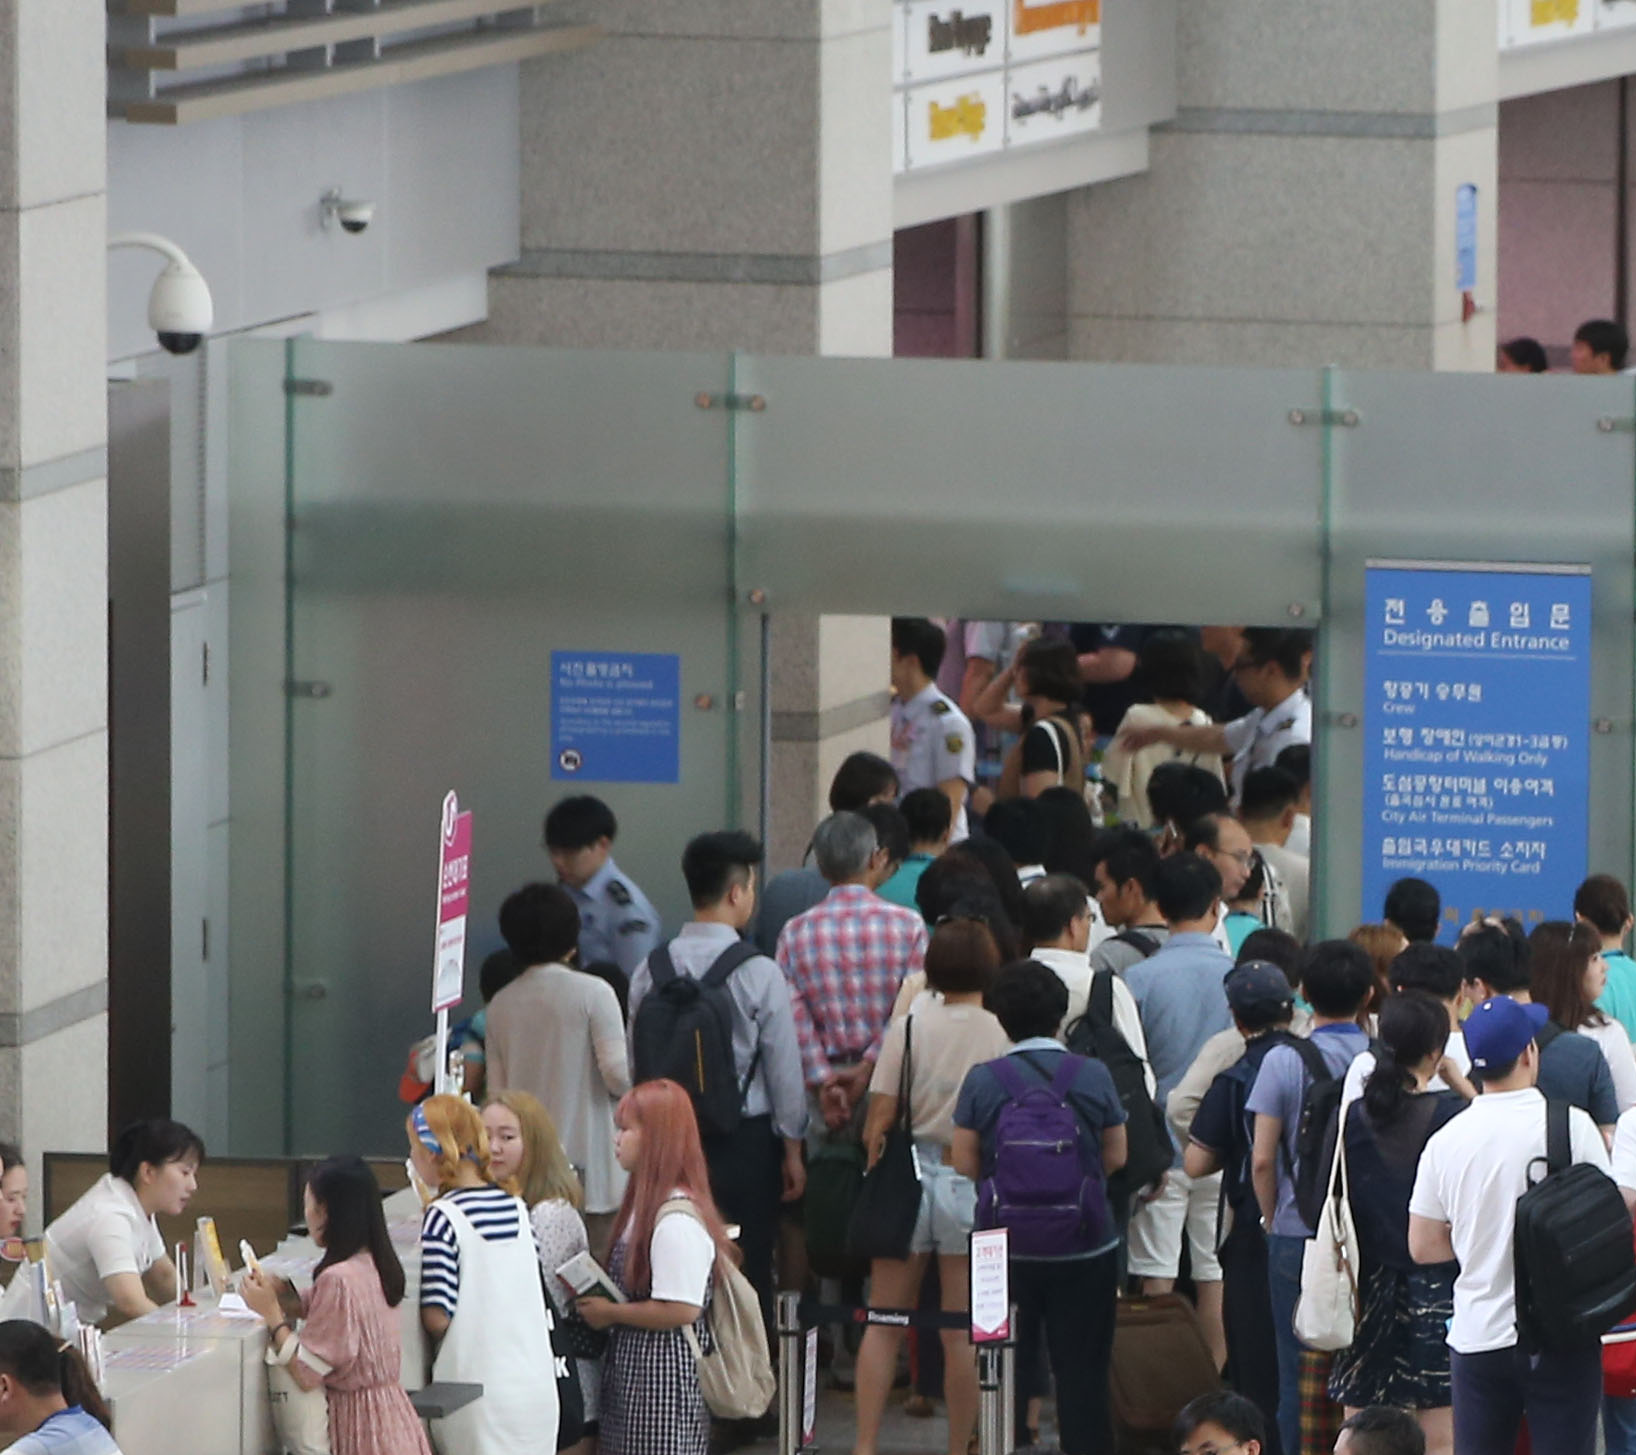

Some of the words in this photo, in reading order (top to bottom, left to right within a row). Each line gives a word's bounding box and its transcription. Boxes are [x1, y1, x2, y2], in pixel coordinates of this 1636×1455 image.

[1383, 629, 1485, 651] Designated
[1491, 631, 1571, 651] Entrance
[1383, 702, 1416, 714] Crew
[1384, 747, 1443, 764] Handicap
[1447, 749, 1460, 762] of
[1464, 750, 1516, 767] Walking
[1519, 752, 1548, 767] Only
[1382, 809, 1406, 825] City
[1409, 810, 1427, 822] Air
[1432, 810, 1484, 824] Terminal
[1487, 812, 1553, 830] Passengers
[1383, 857, 1460, 874] Immigration
[1463, 859, 1508, 875] Priority
[1511, 860, 1541, 874] Card
[868, 1311, 909, 1327] Roaming
